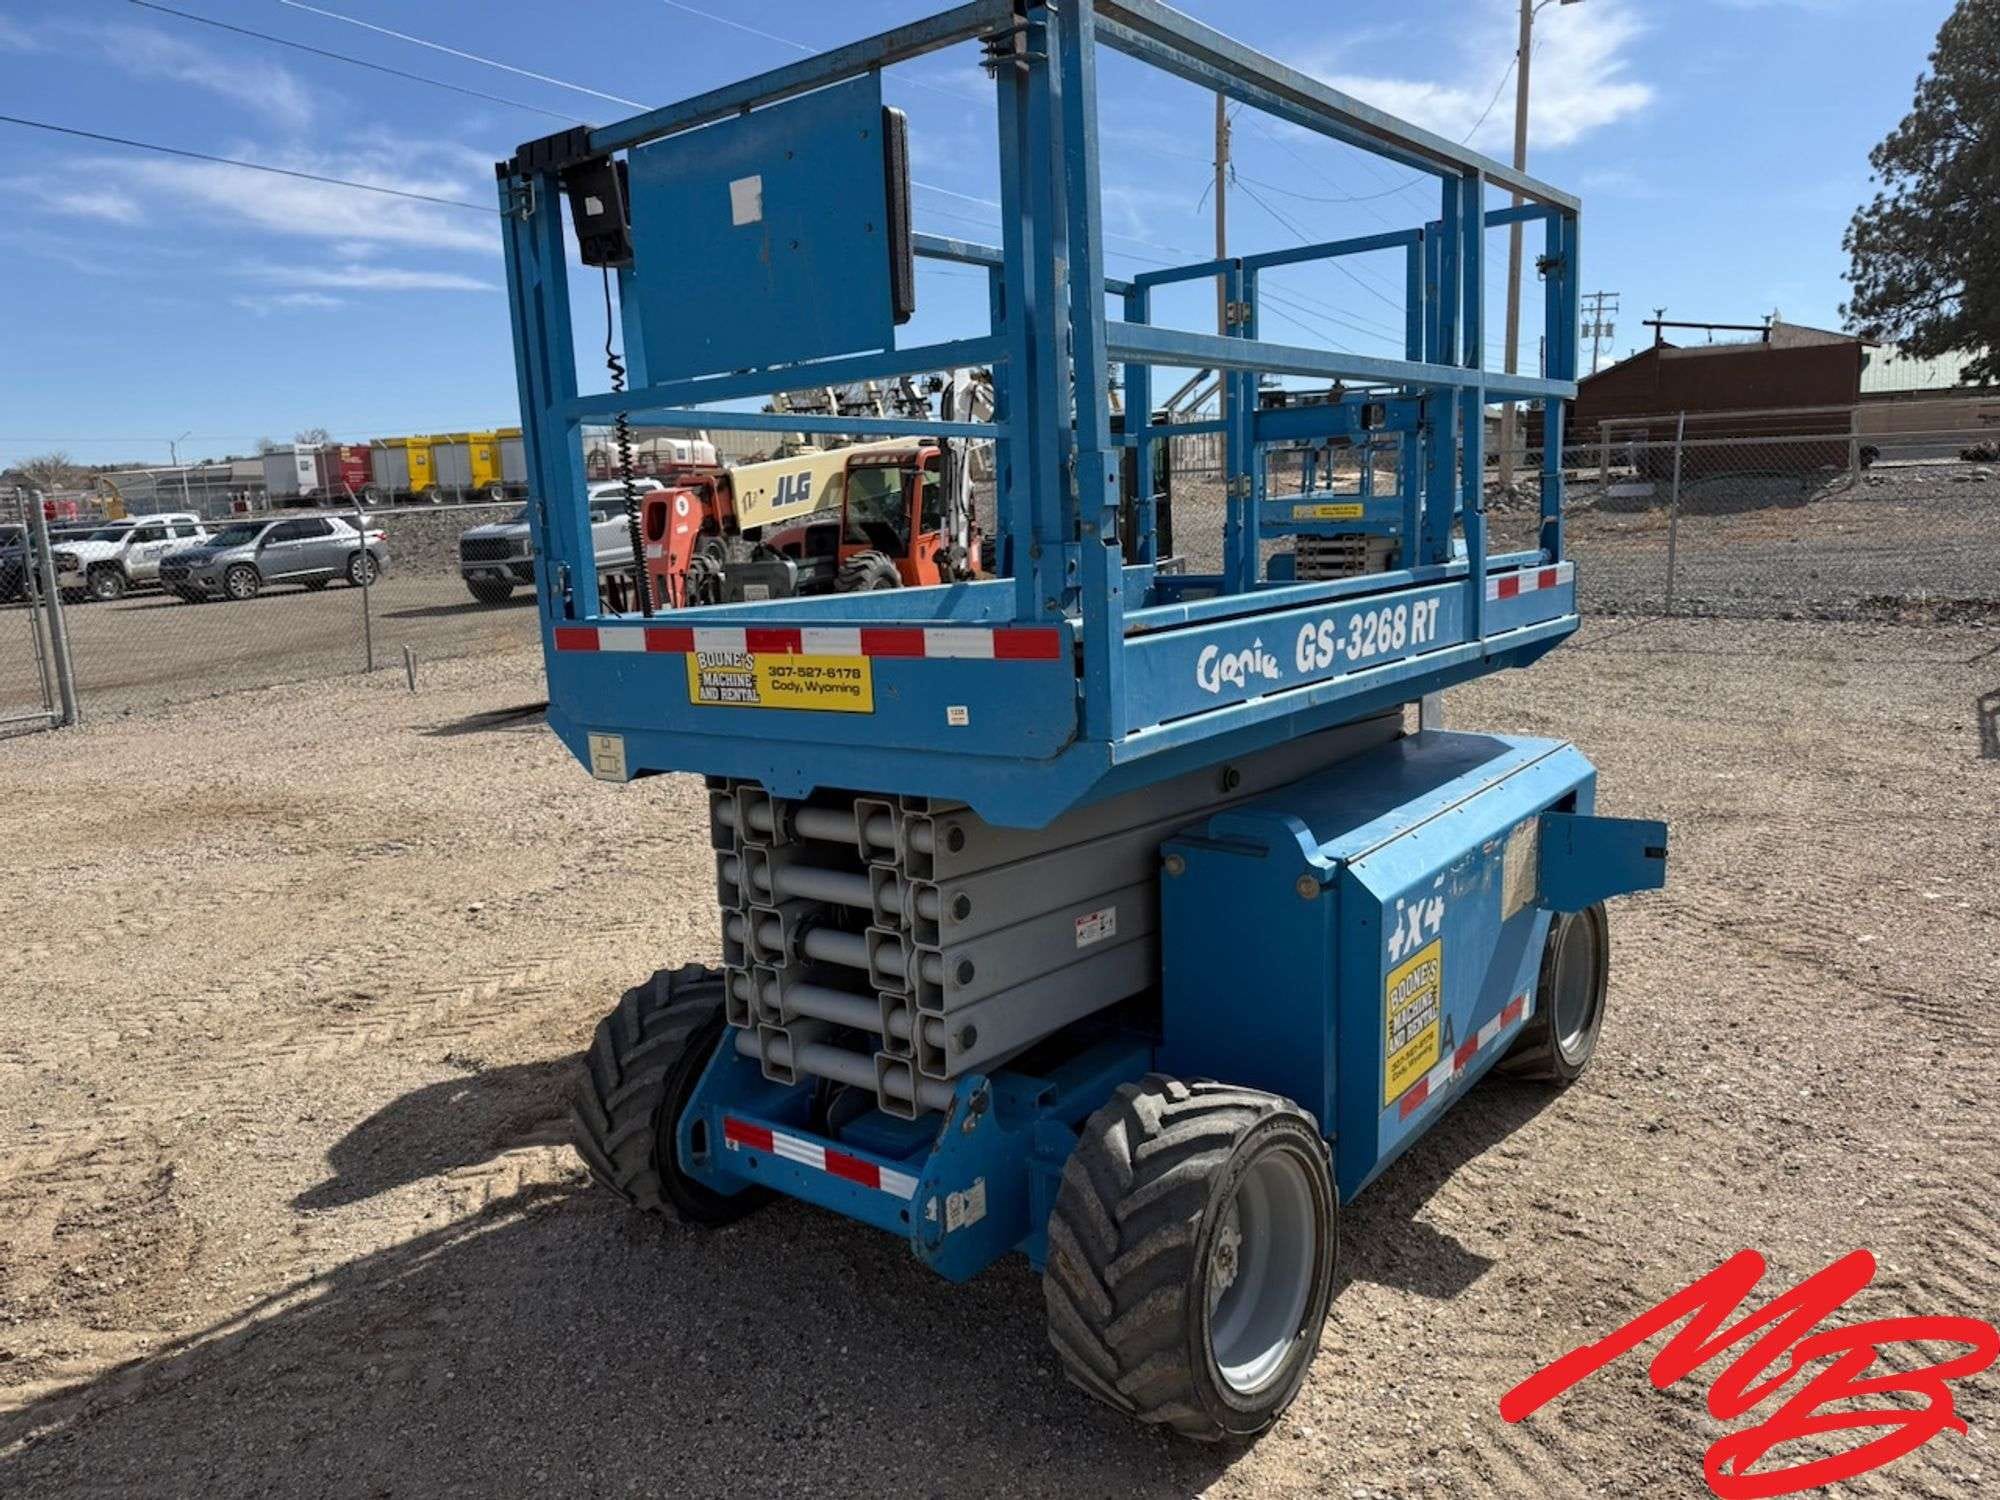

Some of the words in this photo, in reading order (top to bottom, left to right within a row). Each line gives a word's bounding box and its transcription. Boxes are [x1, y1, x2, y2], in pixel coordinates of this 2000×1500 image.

[772, 471, 812, 508] JLG
[1196, 636, 1279, 694] Genie
[1295, 604, 1407, 673] GS-3268
[1410, 597, 1440, 645] RT
[702, 672, 753, 688] MACHINE
[771, 680, 803, 693] Cody,
[804, 681, 861, 697] Wyoming
[699, 687, 719, 701] AND
